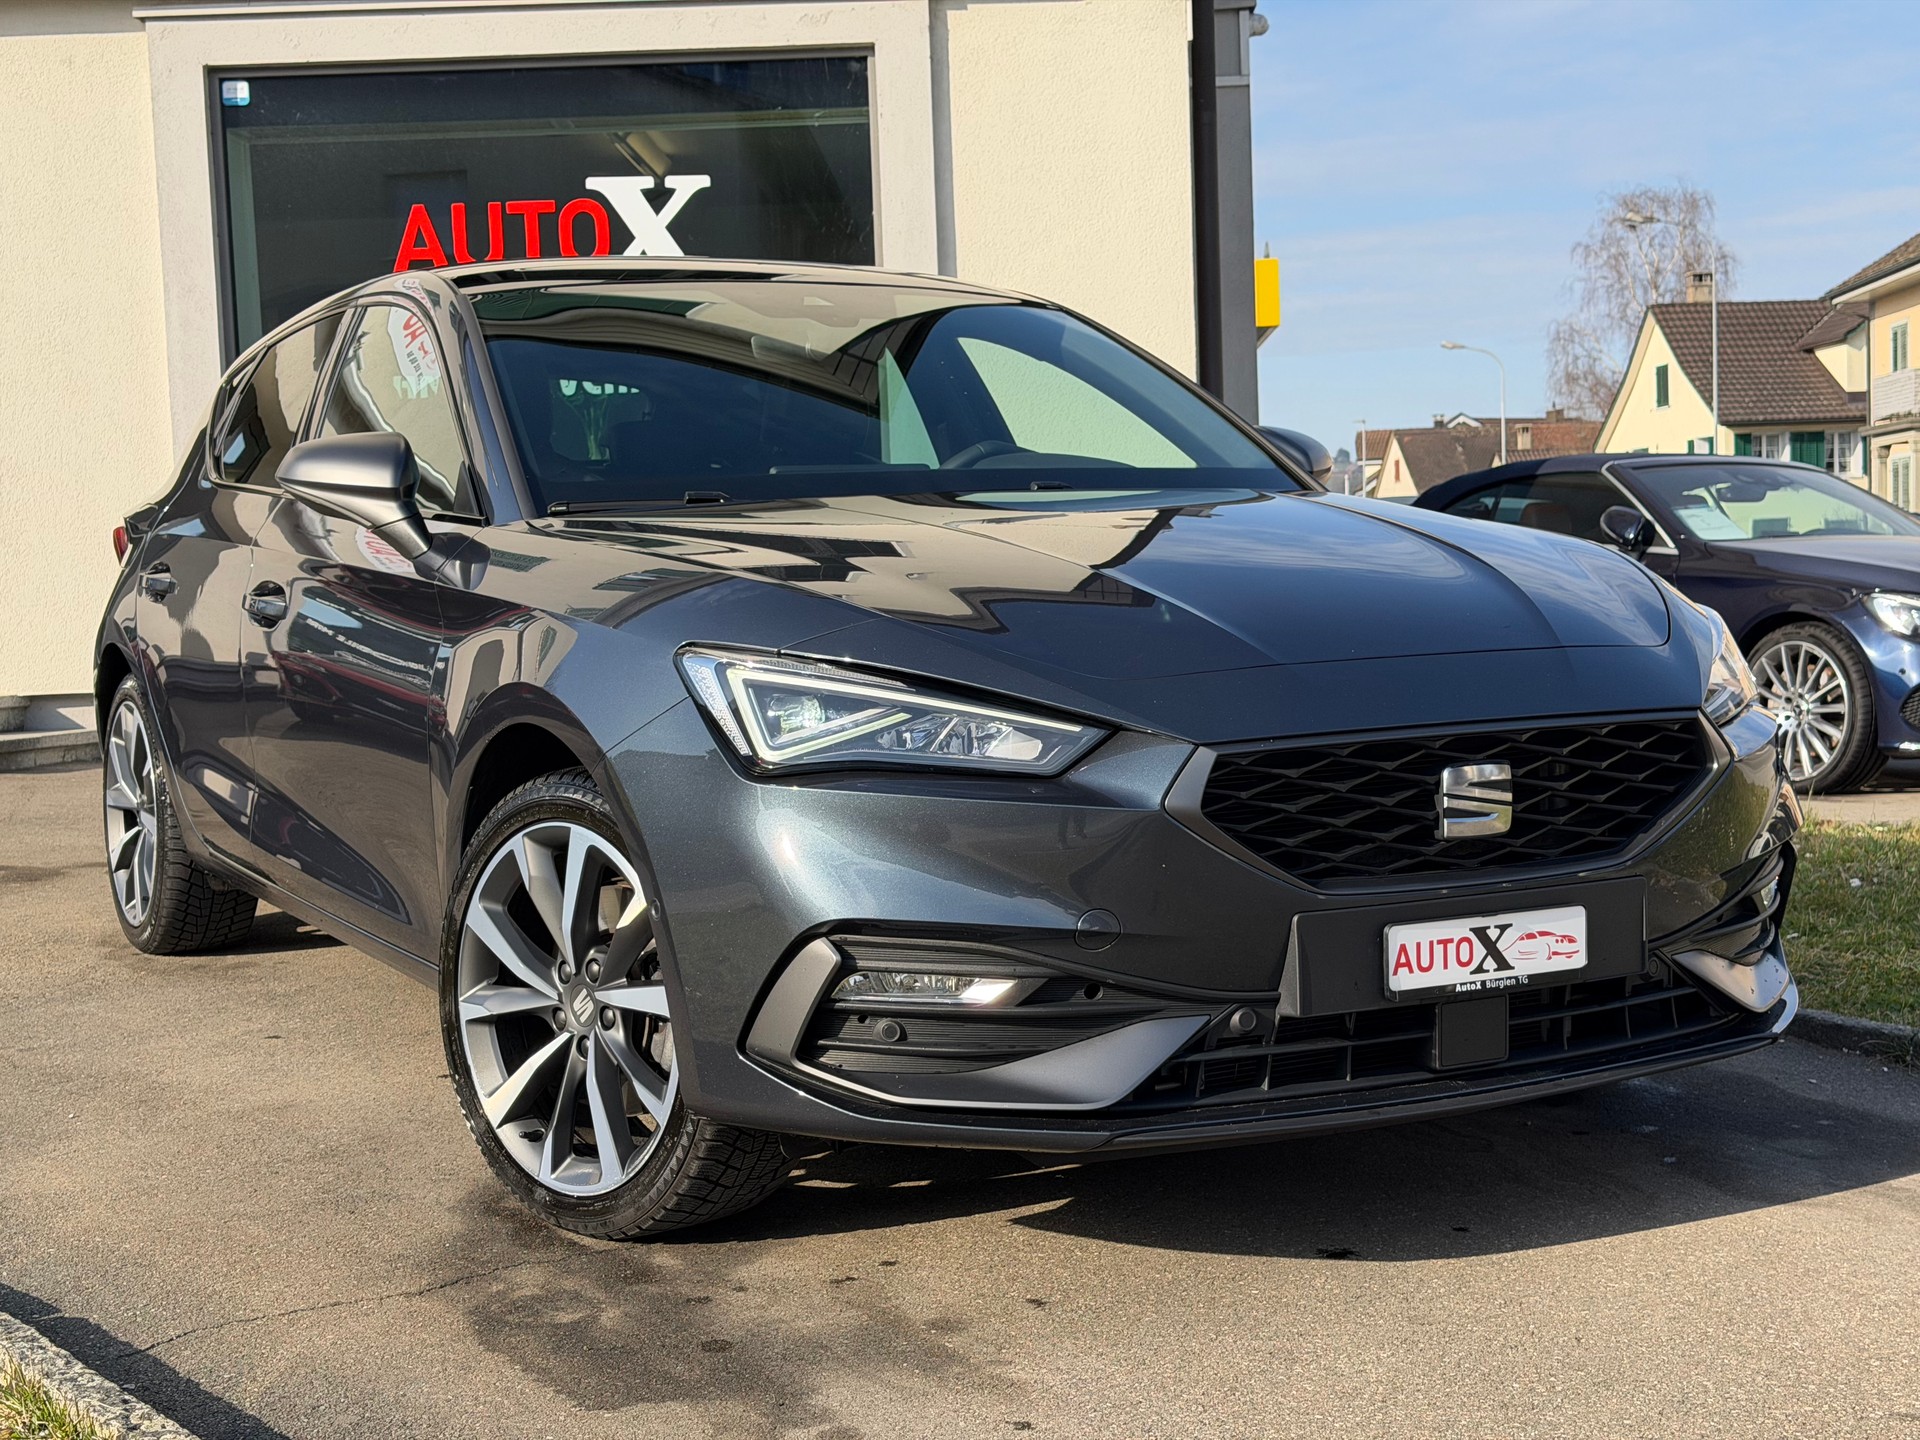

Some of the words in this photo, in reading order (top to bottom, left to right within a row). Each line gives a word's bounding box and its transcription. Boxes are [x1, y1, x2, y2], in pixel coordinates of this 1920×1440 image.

[1392, 923, 1515, 976] AUTOX
[1455, 981, 1482, 992] AutoX
[1486, 978, 1516, 989] Bürglen
[1518, 975, 1529, 985] TG
